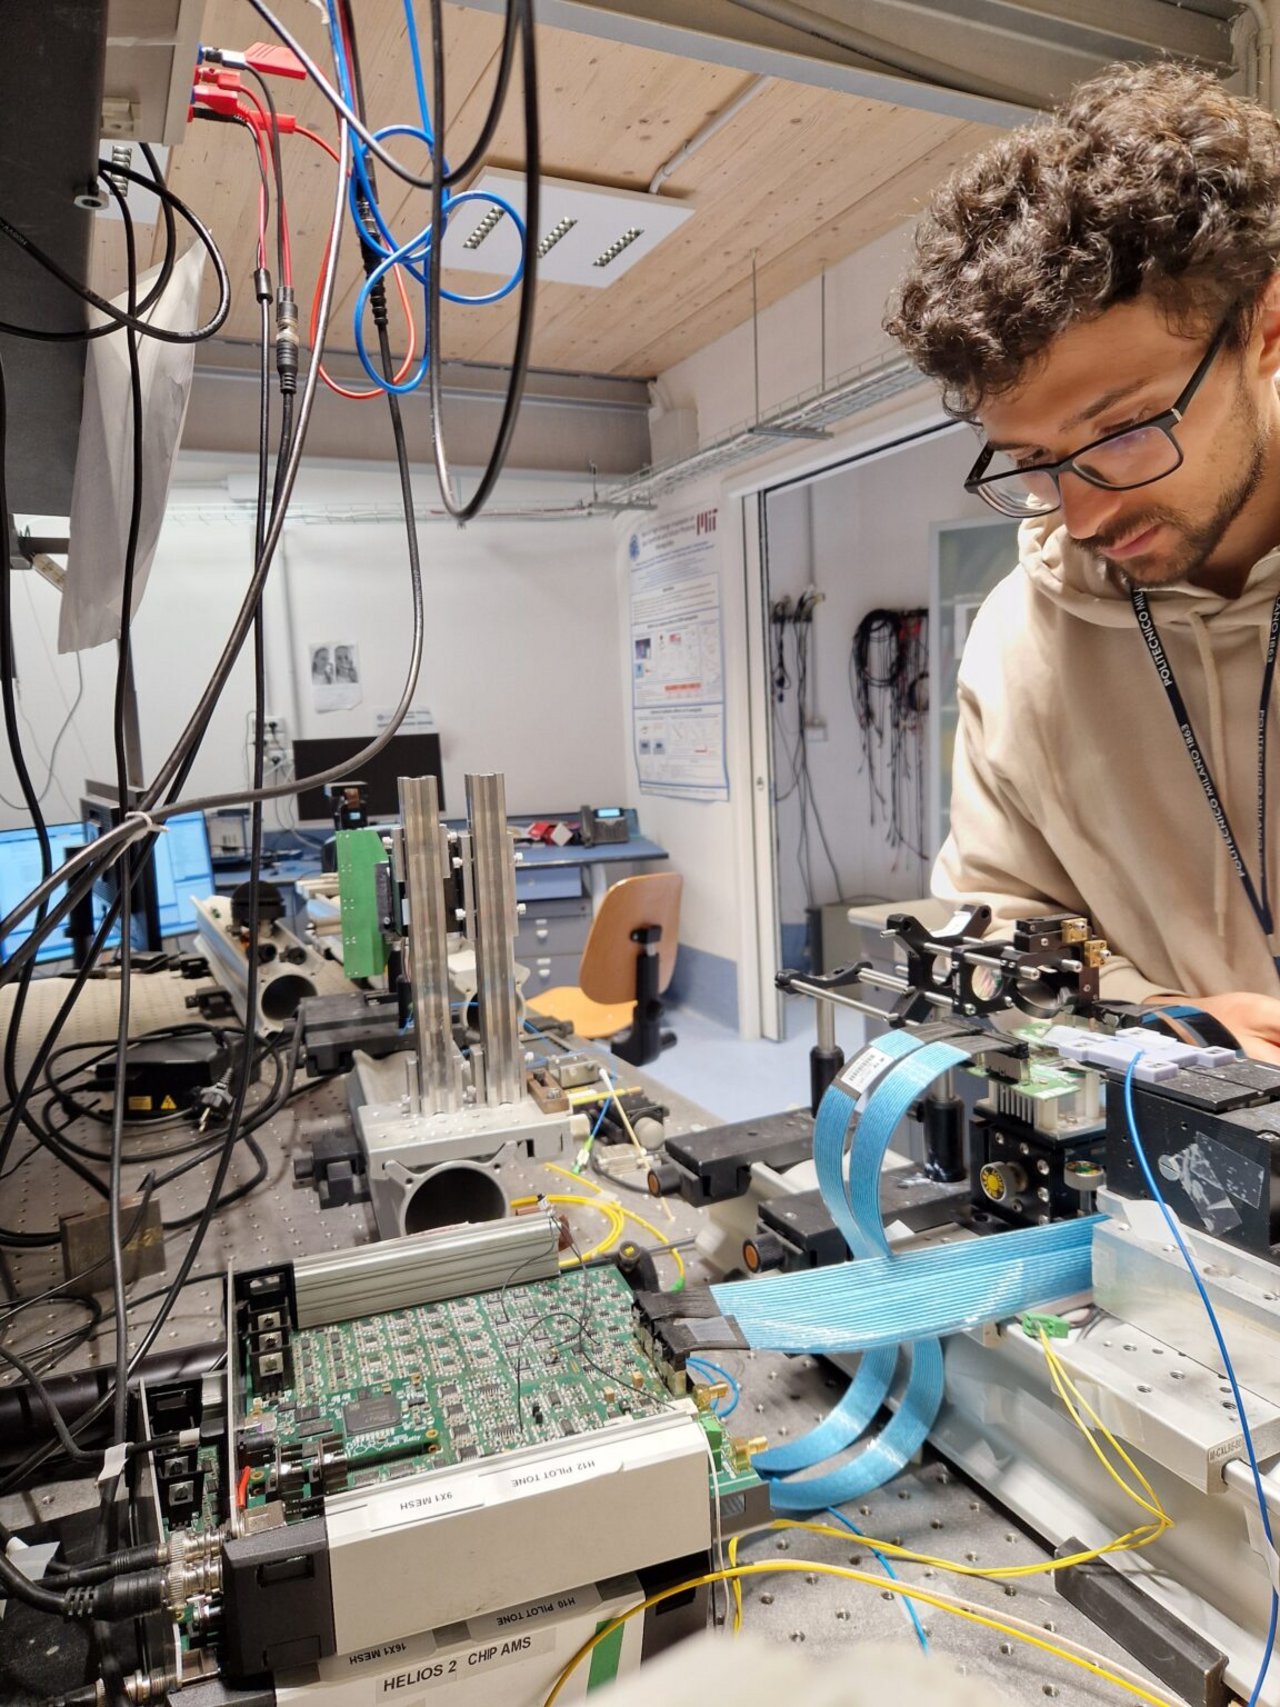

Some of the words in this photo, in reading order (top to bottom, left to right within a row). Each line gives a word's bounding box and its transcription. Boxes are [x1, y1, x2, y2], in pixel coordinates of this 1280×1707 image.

[1138, 611, 1173, 687] POLITECNICO
[1180, 723, 1196, 748] 1863
[1190, 750, 1215, 797] MILANO
[1210, 797, 1246, 878] POLITECNICO
[577, 1460, 596, 1470] H12
[511, 1473, 542, 1488] TONE
[544, 1466, 573, 1481] PILOT
[400, 1496, 432, 1510] MESH
[526, 1603, 554, 1618] PILOT
[558, 1597, 576, 1610] H10
[496, 1612, 525, 1626] TONE
[349, 1648, 382, 1665] MESH
[383, 1642, 406, 1656] 16X1
[383, 1665, 444, 1692] HELIOS
[448, 1660, 458, 1674] 2
[468, 1646, 498, 1667] CHIP
[500, 1636, 532, 1656] AMS
